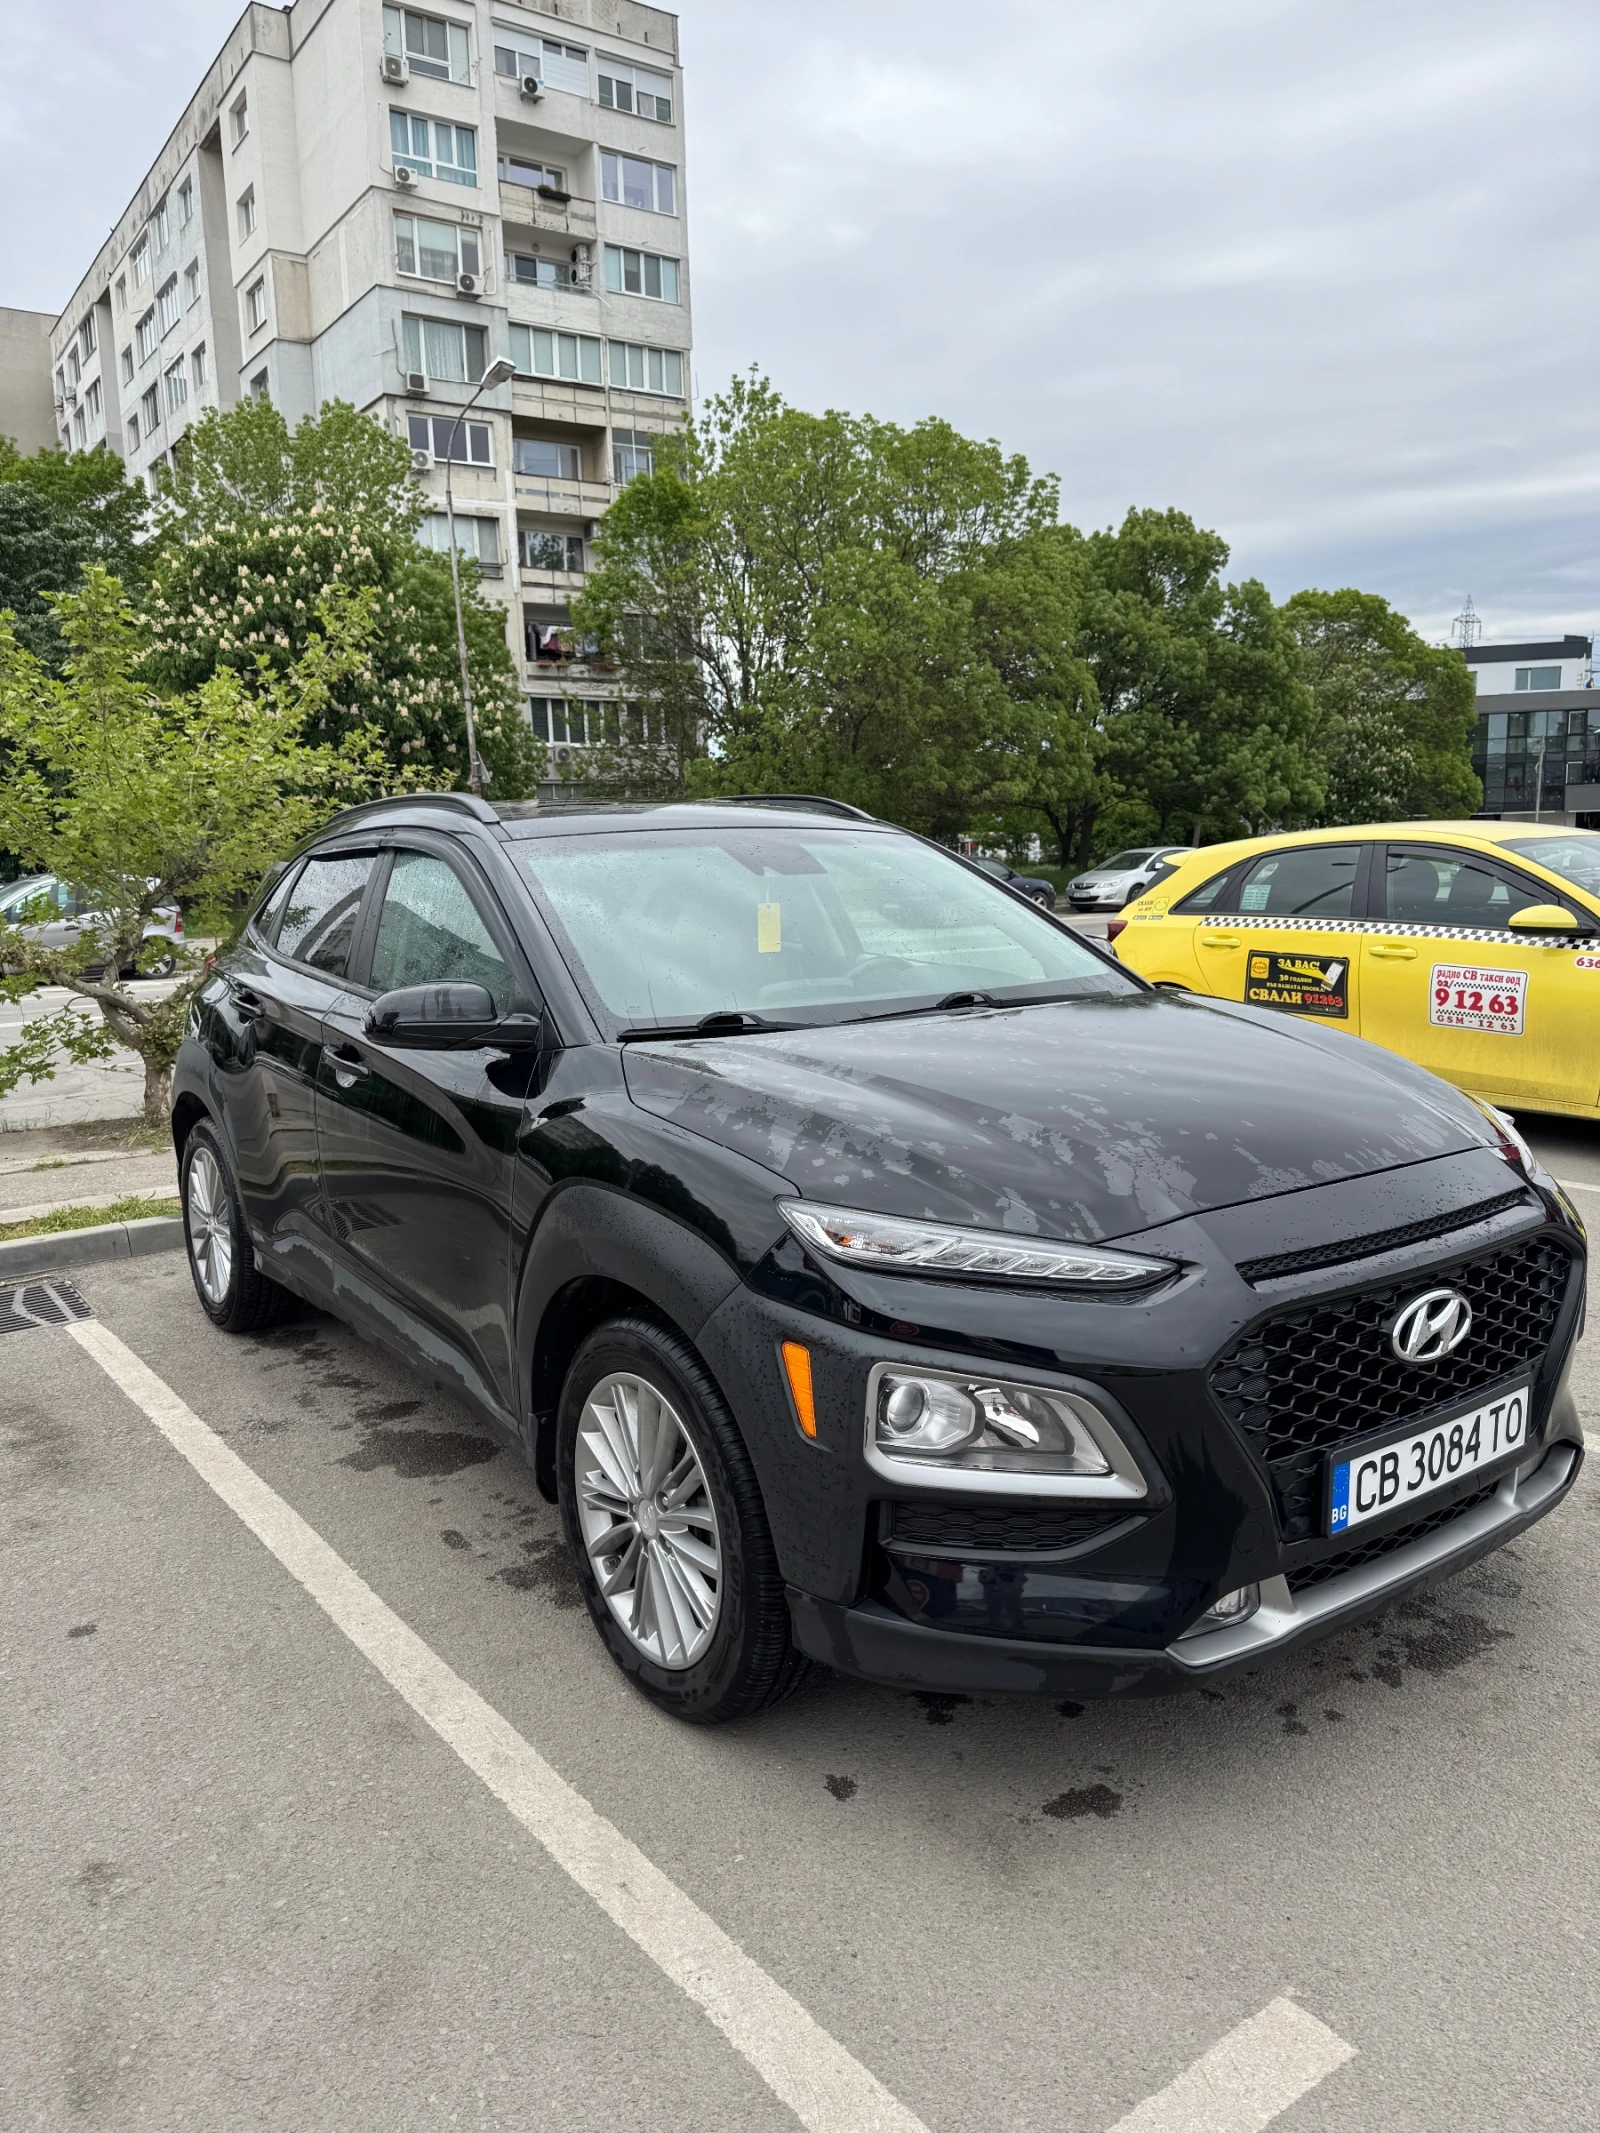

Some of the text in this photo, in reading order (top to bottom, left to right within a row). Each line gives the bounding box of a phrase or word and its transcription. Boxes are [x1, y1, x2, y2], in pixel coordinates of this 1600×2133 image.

[1277, 959, 1293, 969] ЗА
[1295, 961, 1321, 971] ВАС!
[1279, 974, 1289, 982] 30
[1436, 969, 1521, 987] радио СВ такси оод
[1250, 988, 1344, 1008] СВАЛИ 91263
[1437, 1015, 1465, 1025] GSM
[1356, 1451, 1400, 1513] CB
[1407, 1414, 1482, 1491] 3084
[1332, 1504, 1347, 1524] BG
